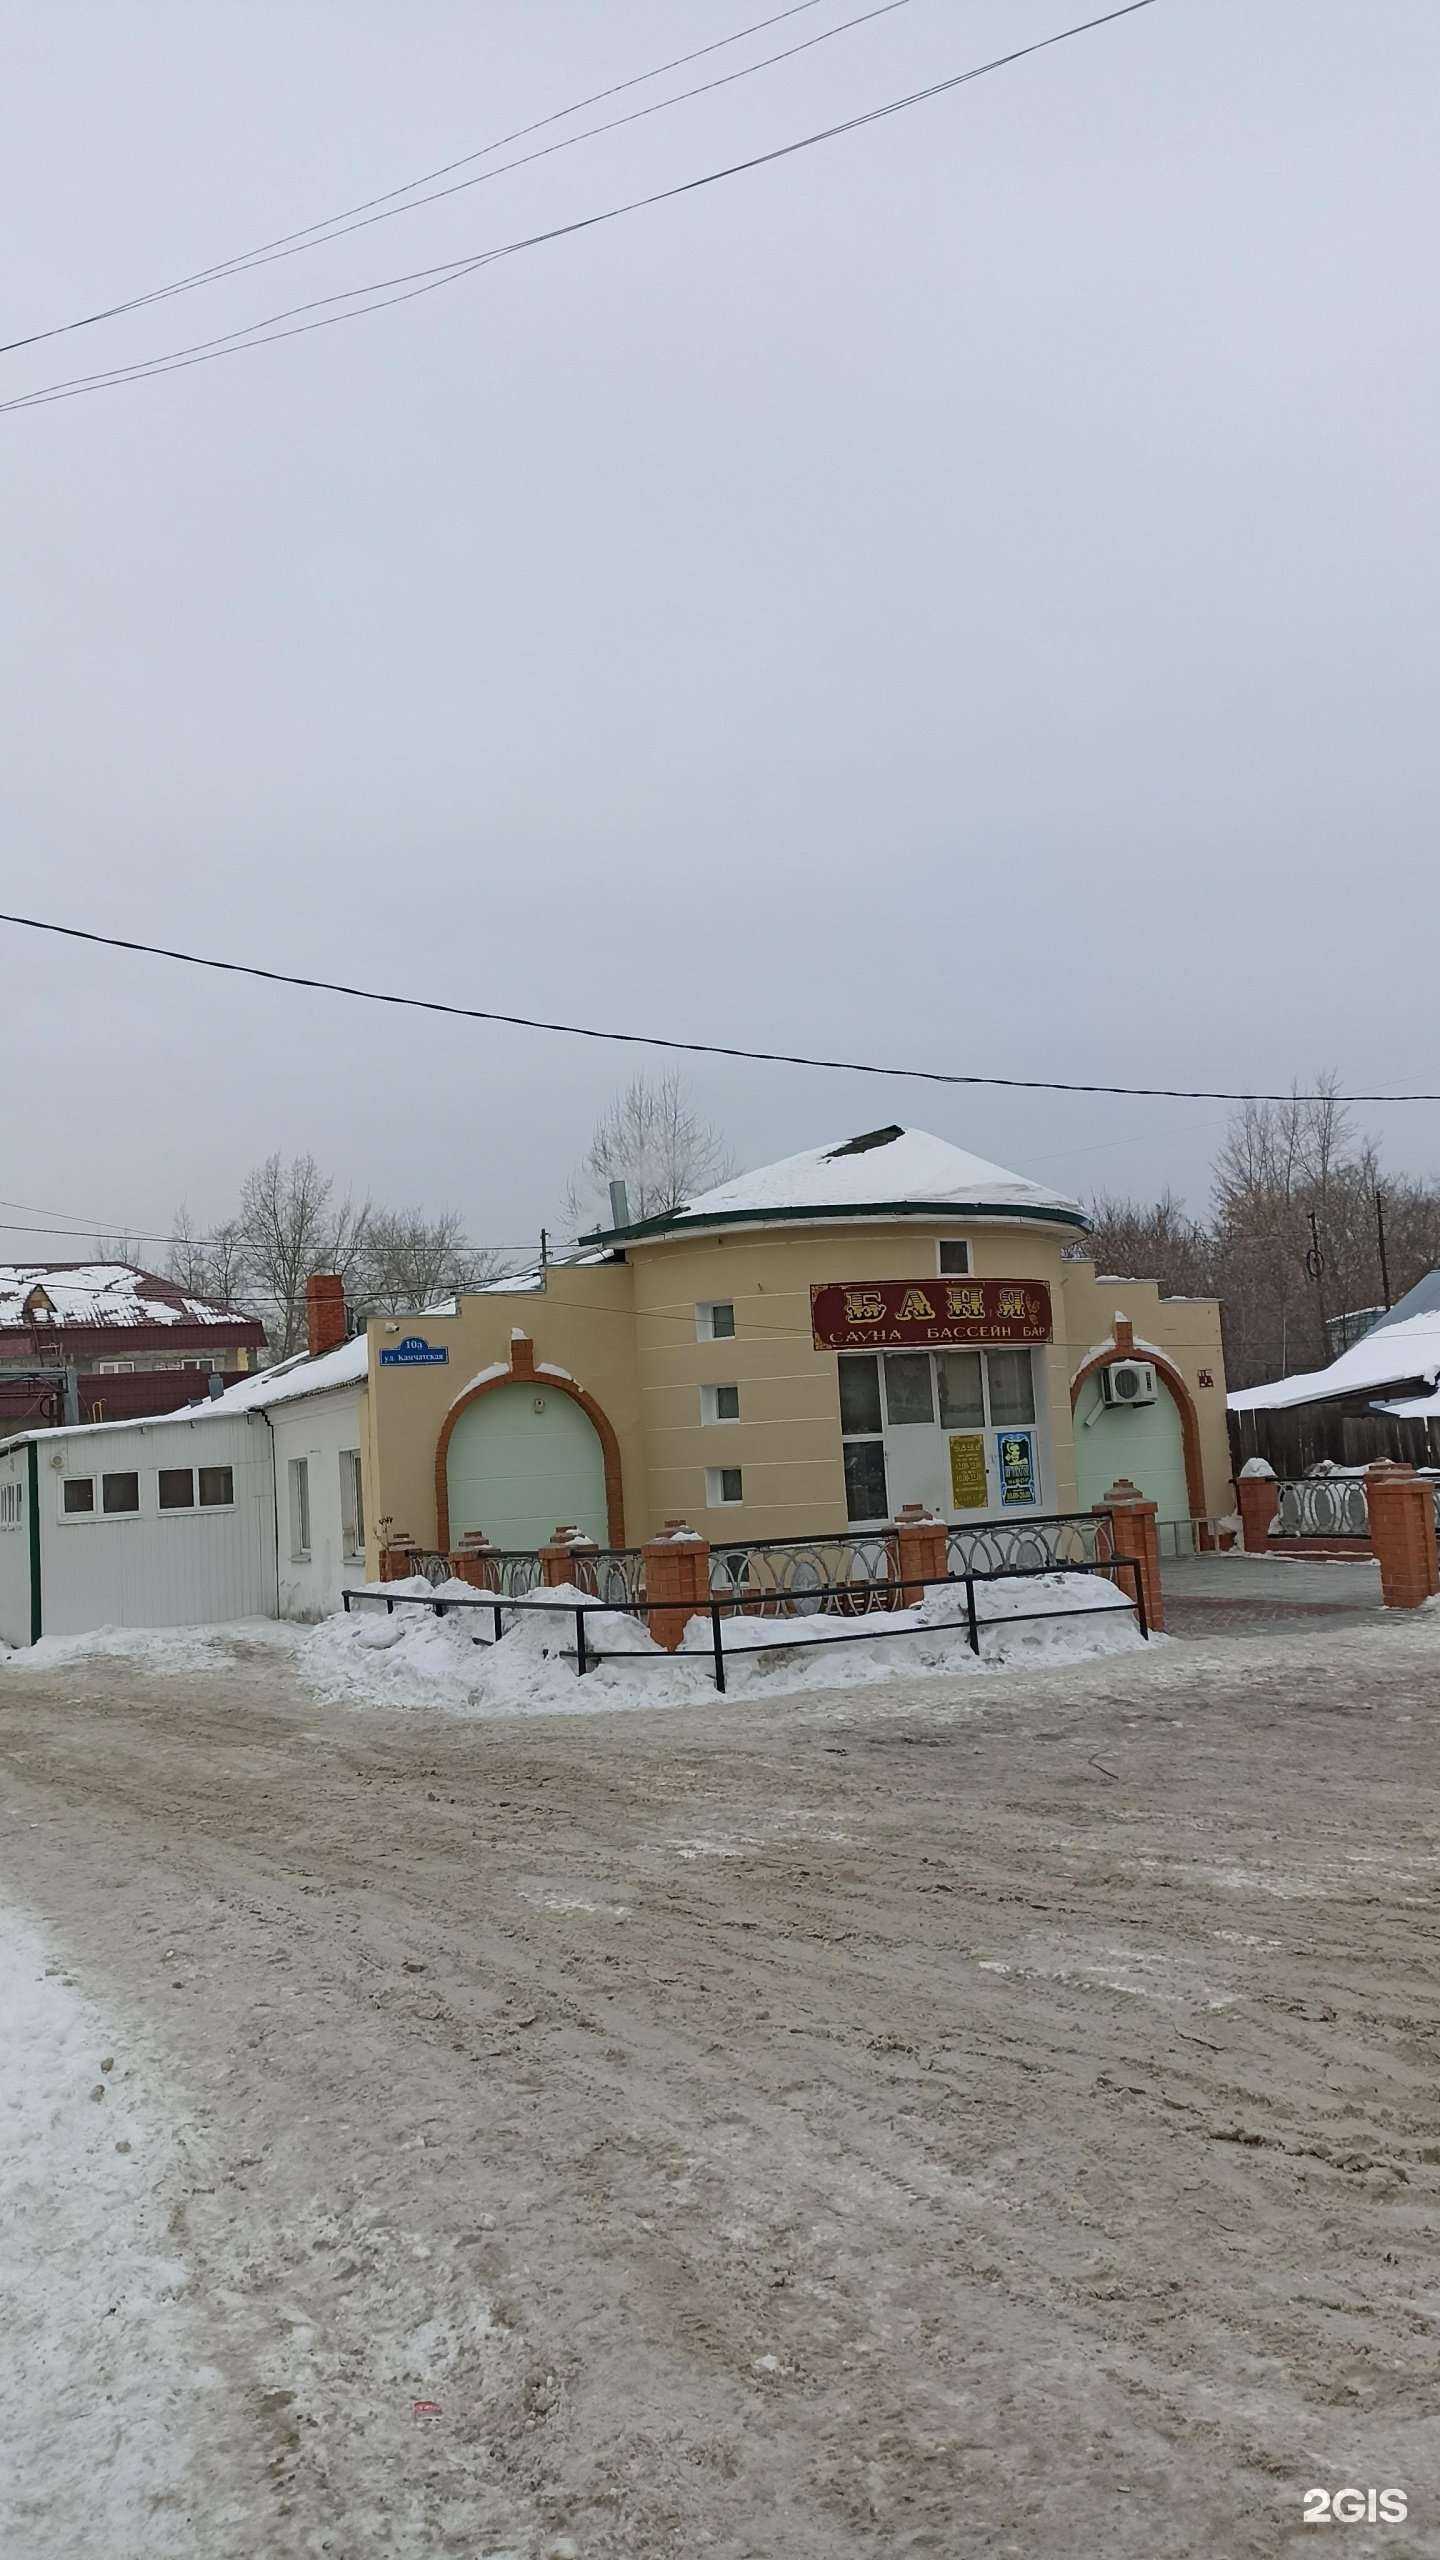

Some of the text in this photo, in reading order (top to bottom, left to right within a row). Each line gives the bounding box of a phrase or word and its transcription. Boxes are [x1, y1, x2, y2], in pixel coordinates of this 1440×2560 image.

[845, 1288, 1025, 1324] БАНЯ
[829, 1326, 1046, 1343] САУНА БАССЕЙН БАР
